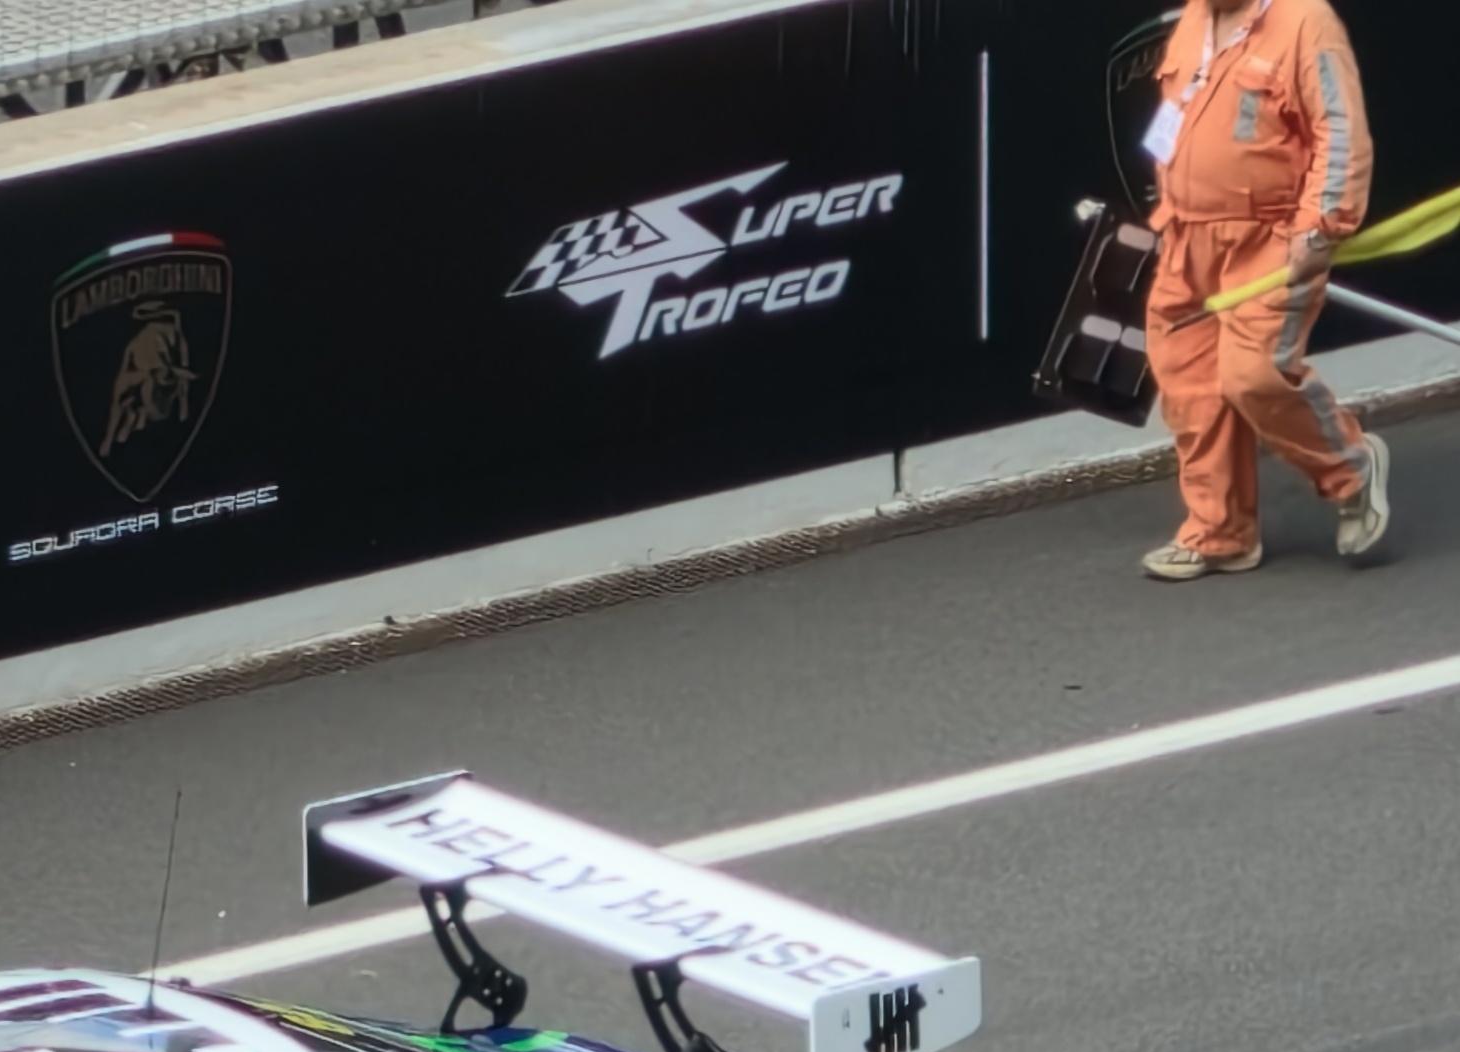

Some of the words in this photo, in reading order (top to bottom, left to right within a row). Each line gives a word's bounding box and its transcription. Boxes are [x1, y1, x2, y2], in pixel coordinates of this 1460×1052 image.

[556, 161, 903, 284] SUPER
[558, 247, 850, 359] TROFEO
[9, 511, 159, 561] SQUADRA
[171, 485, 279, 524] CORSE
[387, 808, 625, 892] HELLY
